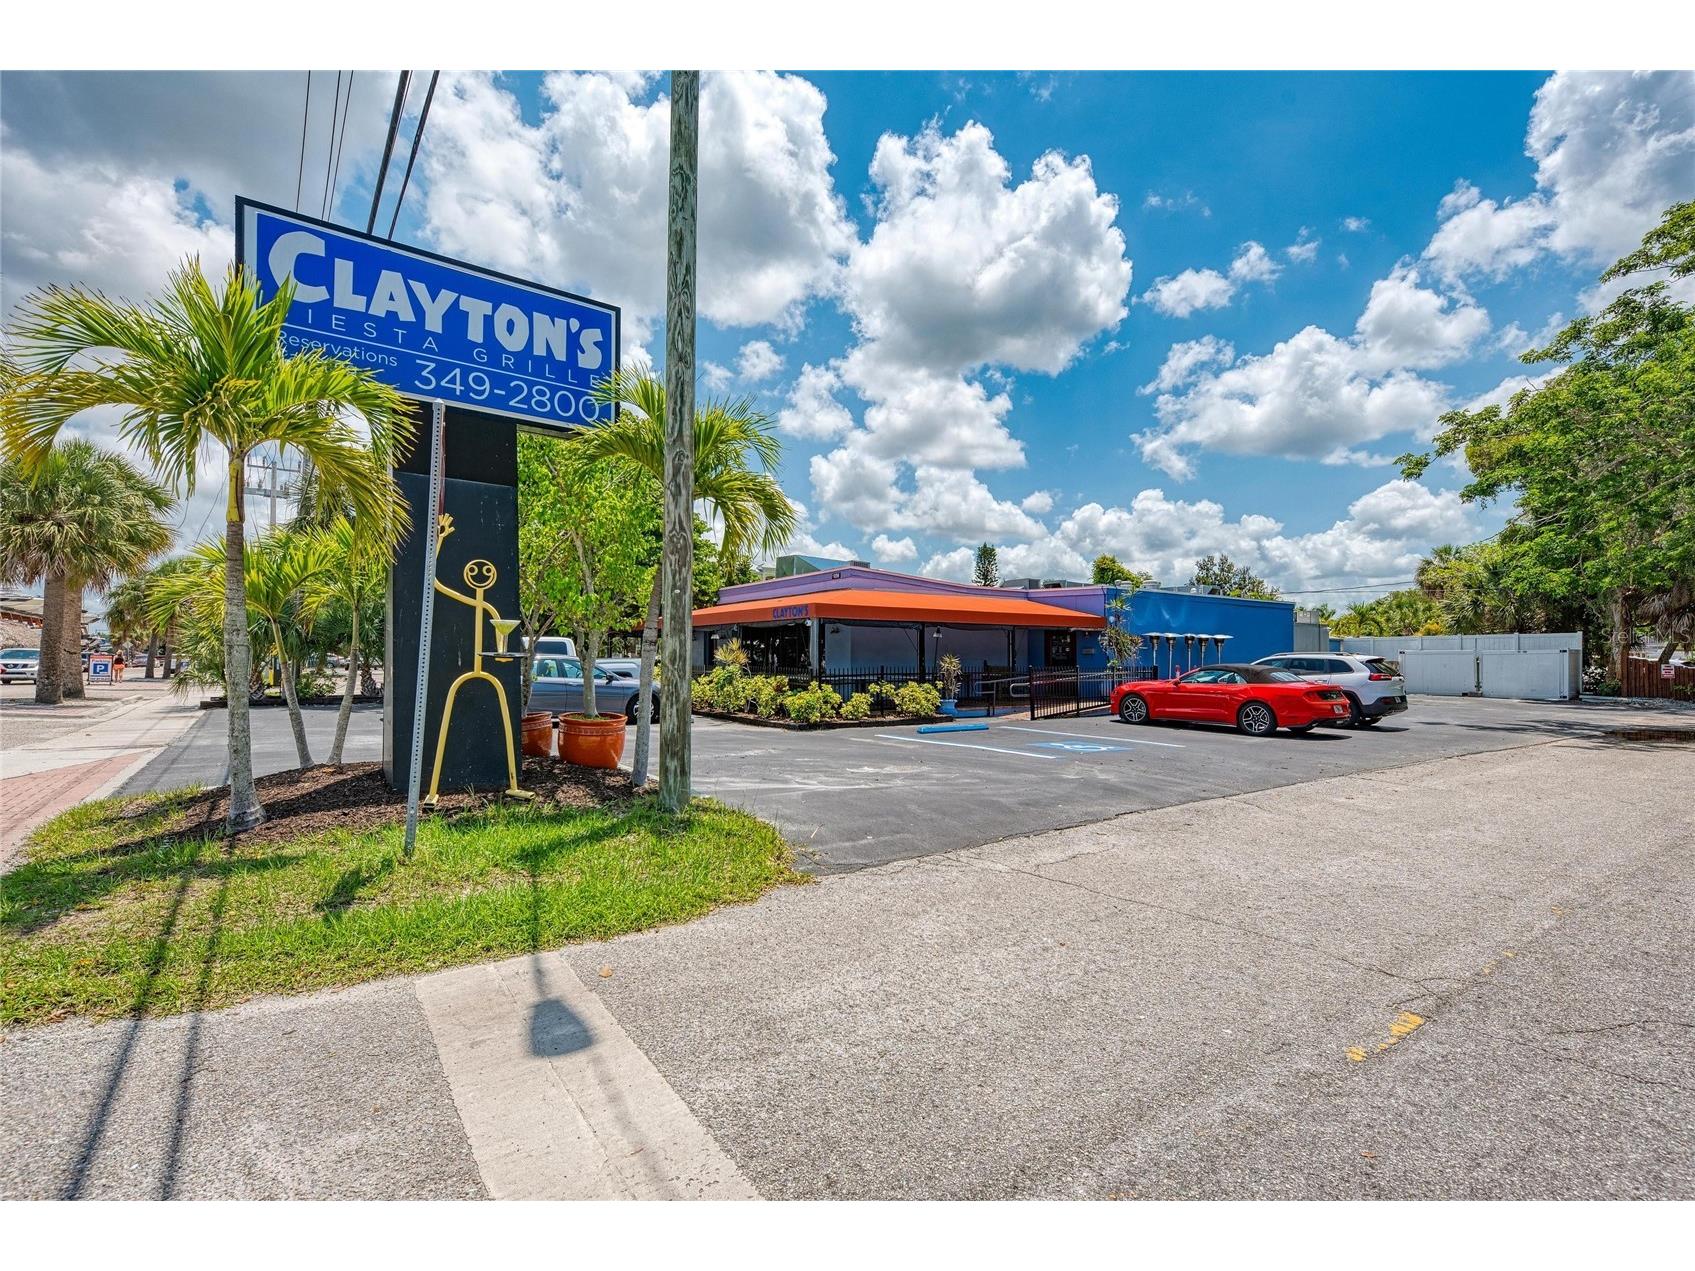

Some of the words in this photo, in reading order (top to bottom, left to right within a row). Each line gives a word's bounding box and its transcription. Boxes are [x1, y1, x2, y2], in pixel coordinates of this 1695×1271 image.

[268, 231, 603, 369] CLAYTON'S
[279, 330, 398, 367] Reservations
[282, 302, 439, 353] IESTA
[473, 347, 601, 388] GRILLE
[414, 359, 600, 423] 349-2800
[772, 605, 809, 619] CLAYTON'S
